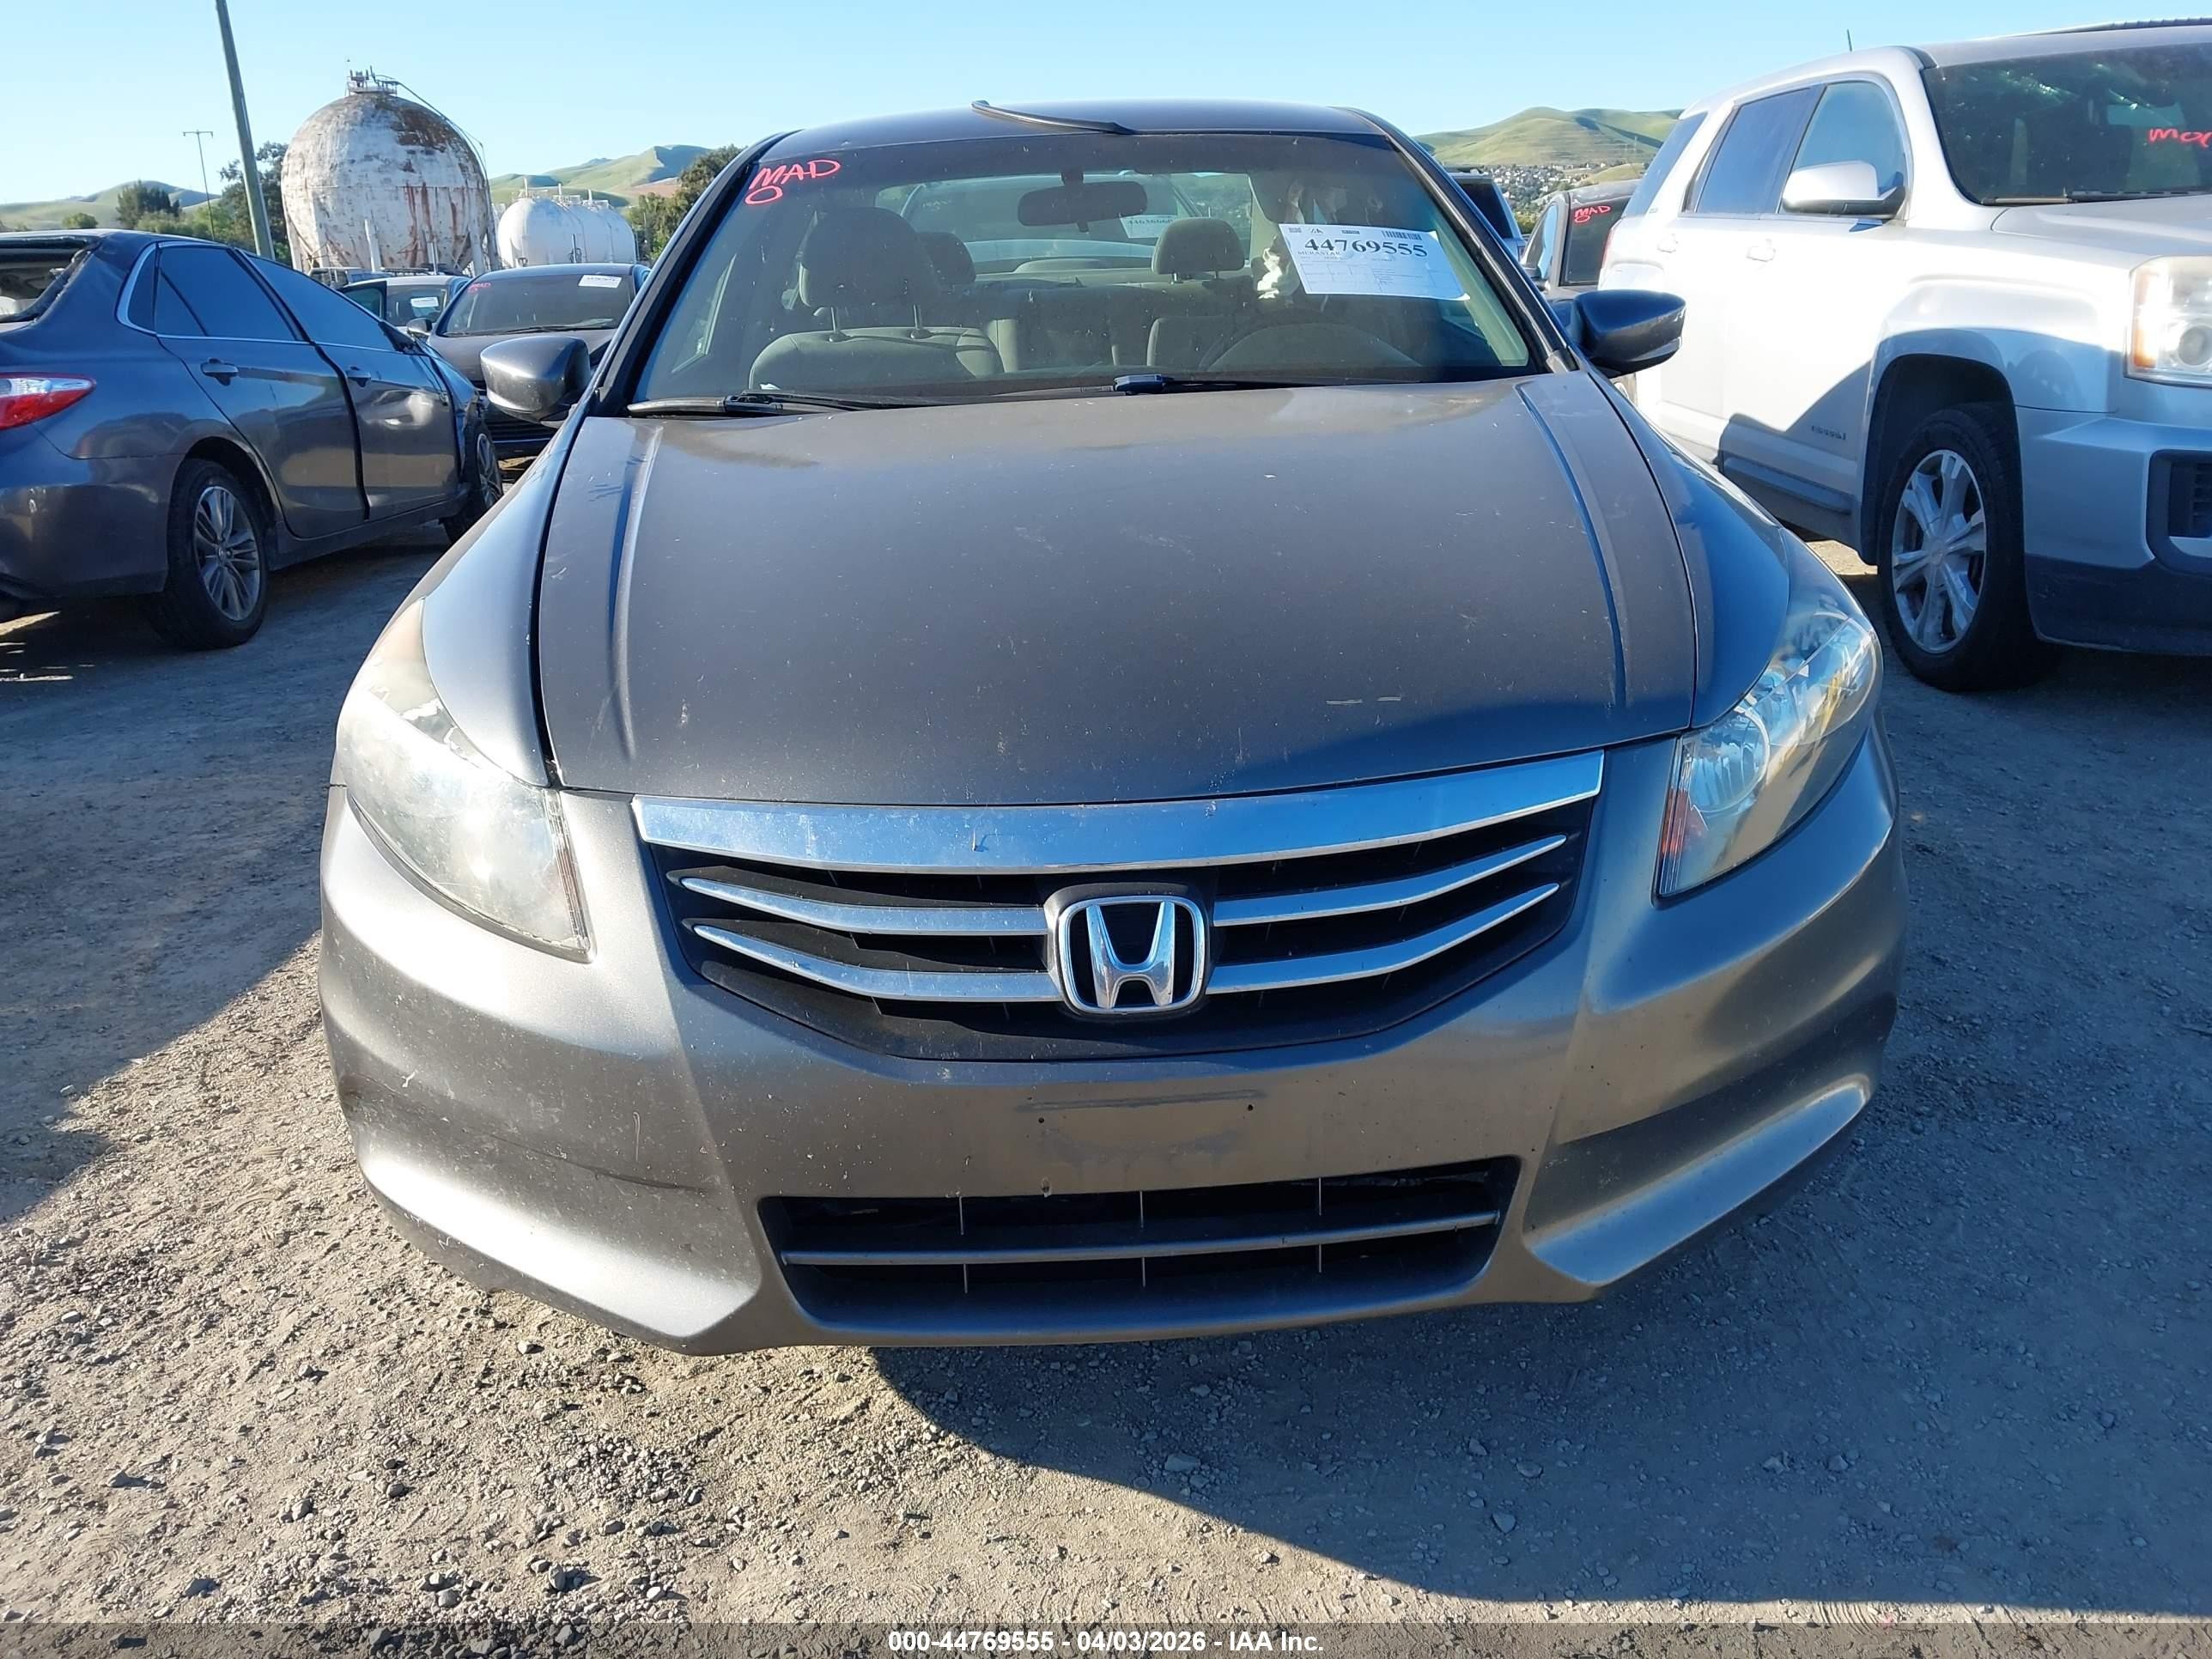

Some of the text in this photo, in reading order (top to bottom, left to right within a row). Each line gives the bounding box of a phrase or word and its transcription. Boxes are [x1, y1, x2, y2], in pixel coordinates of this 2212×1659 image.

[749, 160, 841, 189] MAD
[1575, 206, 1611, 217] MAD
[1305, 239, 1427, 257] 44769555
